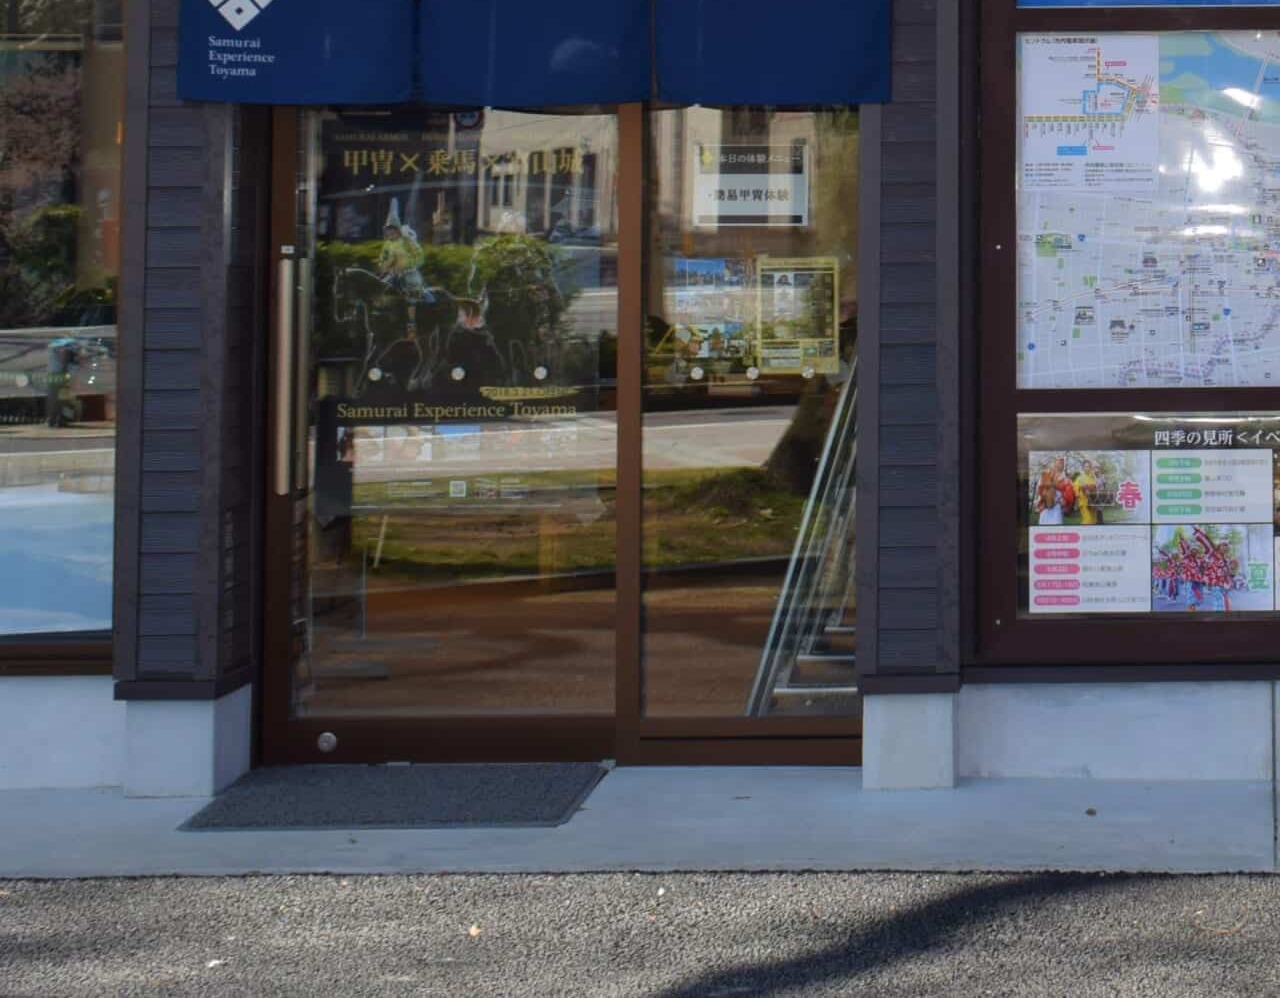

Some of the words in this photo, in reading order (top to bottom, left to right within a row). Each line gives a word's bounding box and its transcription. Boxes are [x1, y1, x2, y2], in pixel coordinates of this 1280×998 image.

[208, 35, 261, 48] Samurai
[208, 50, 275, 65] Experience
[208, 64, 256, 80] Toyama
[336, 402, 408, 419] Samurai
[414, 402, 505, 420] Experience
[510, 402, 577, 422] Toyama
[1118, 482, 1142, 509] 春
